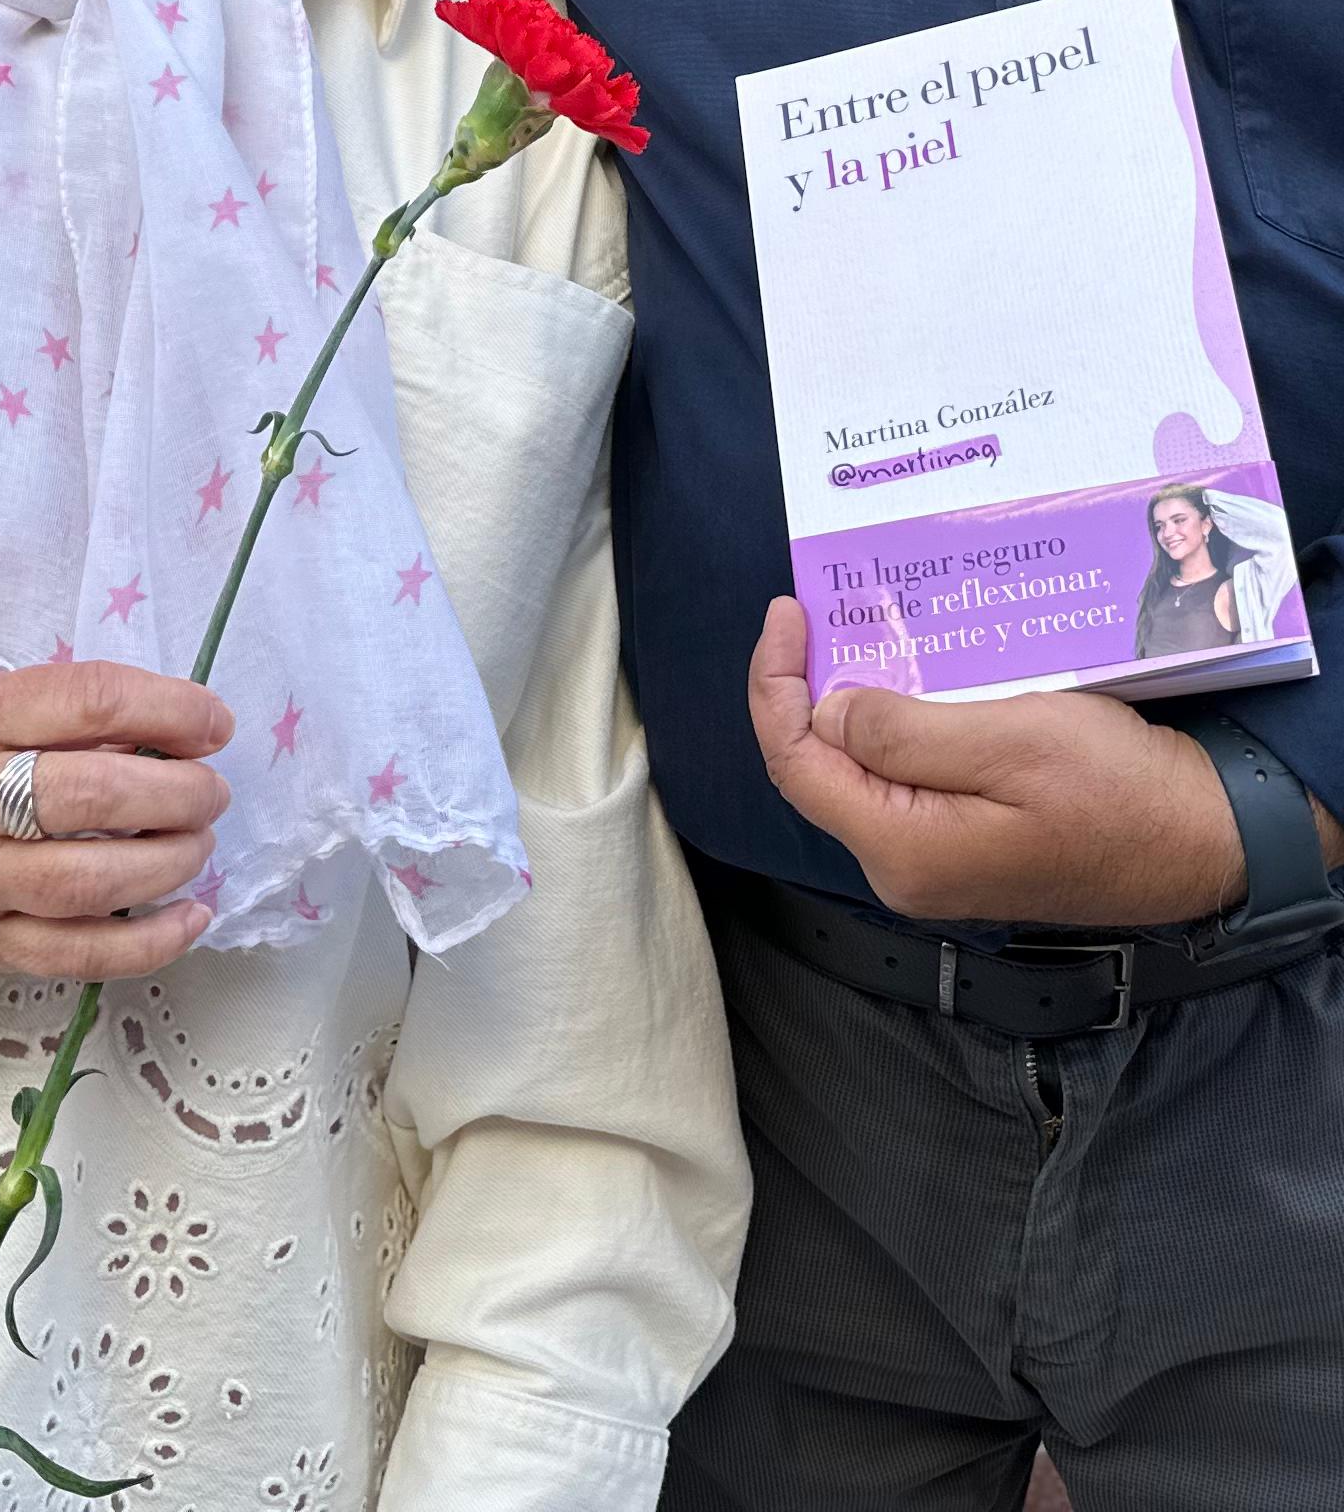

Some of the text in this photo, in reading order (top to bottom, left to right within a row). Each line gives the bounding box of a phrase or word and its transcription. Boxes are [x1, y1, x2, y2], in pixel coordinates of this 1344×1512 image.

[776, 26, 1101, 141] Entre el papel
[784, 119, 962, 212] y la piel
[824, 387, 1055, 453] Martina González
[832, 443, 997, 487] @martiinag
[823, 536, 1066, 591] Tu lugar seguro
[828, 567, 1111, 628] donde reflexionar,
[829, 603, 1125, 670] inspirarte y crecer.
